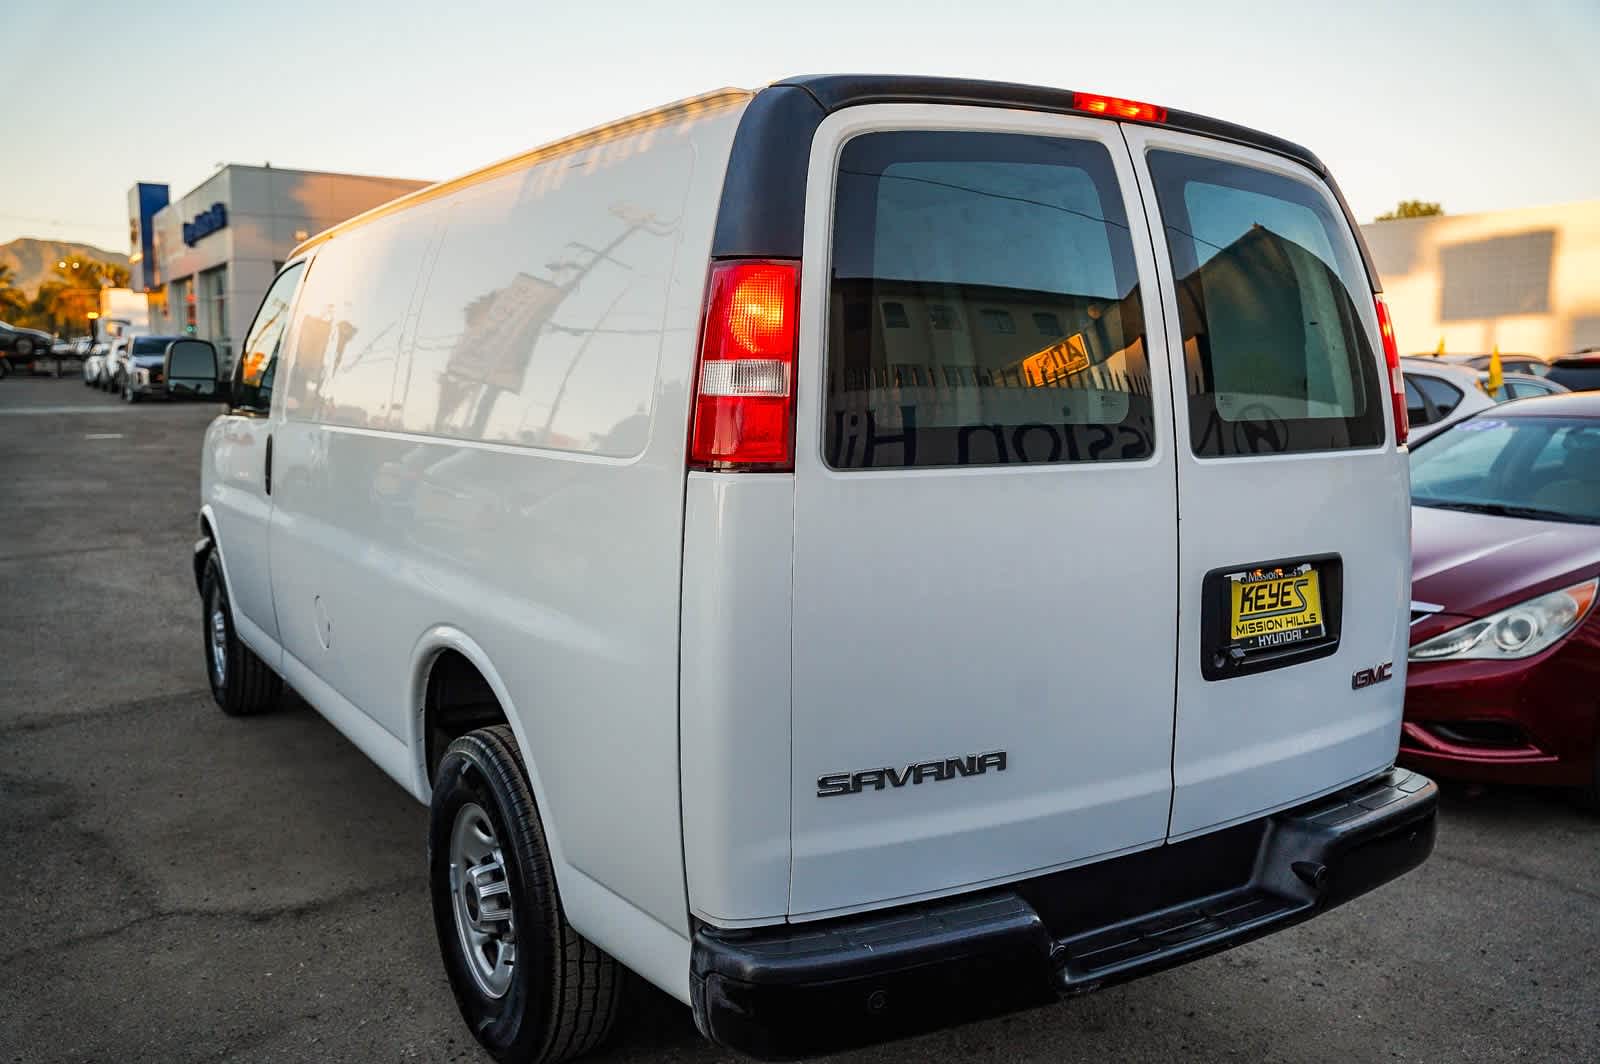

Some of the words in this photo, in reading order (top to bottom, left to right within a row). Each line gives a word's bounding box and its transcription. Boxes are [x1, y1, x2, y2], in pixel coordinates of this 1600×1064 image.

[1240, 579, 1308, 615] KEYES
[1235, 618, 1283, 636] MISSION
[1286, 612, 1317, 628] HILLS
[1258, 628, 1302, 647] HYUNDAI
[1352, 661, 1393, 690] GMC
[816, 750, 1007, 798] SAVANA
